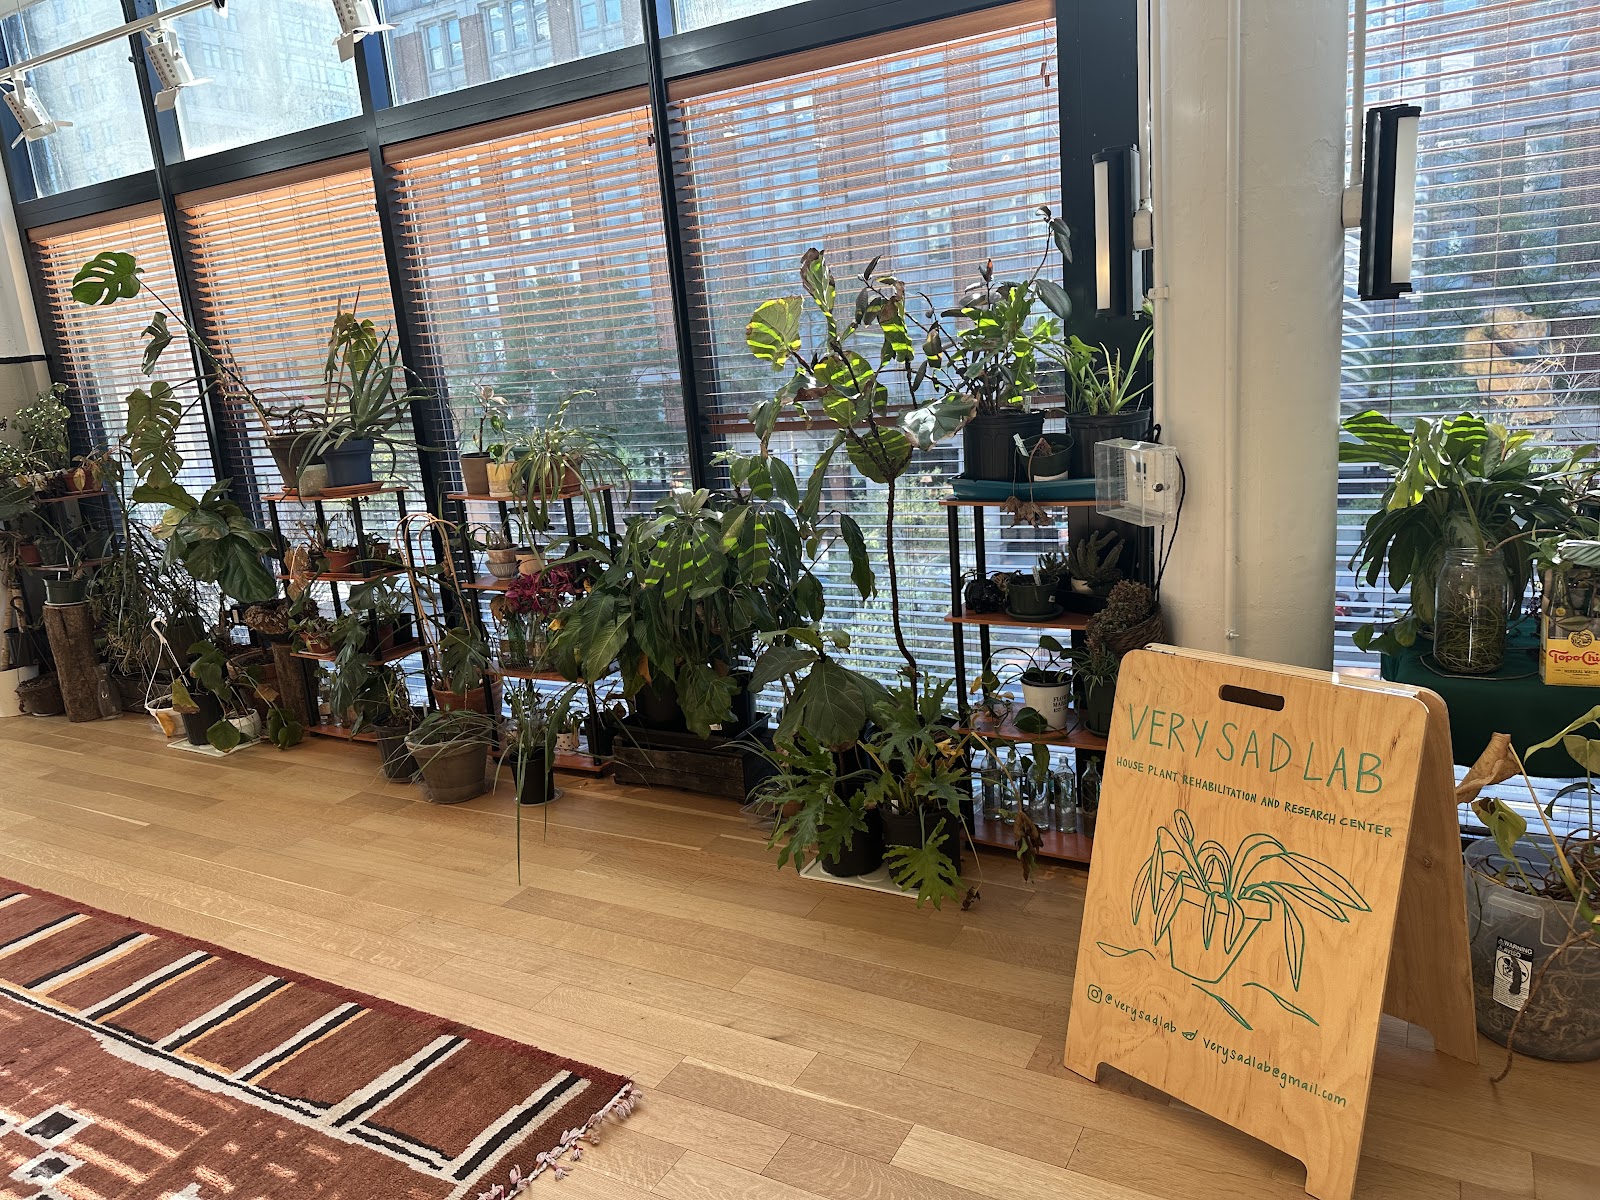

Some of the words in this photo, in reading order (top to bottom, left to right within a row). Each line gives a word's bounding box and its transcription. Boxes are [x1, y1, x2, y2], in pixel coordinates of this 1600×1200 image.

[1549, 650, 1581, 663] Topo
[1581, 651, 1600, 666] Chi
[1128, 703, 1208, 757] VERY
[1216, 722, 1292, 773] SAD
[1303, 741, 1383, 794] LAB
[1116, 757, 1143, 773] HOUSE
[1148, 765, 1178, 782] PLANT
[1182, 774, 1257, 803] REHABILITATION
[1261, 796, 1280, 809] AND
[1284, 801, 1336, 825] RESEARCH
[1339, 817, 1392, 837] CENTER
[1504, 940, 1533, 955] WARNING
[1203, 1037, 1346, 1108] verysadlab@gmail.com
